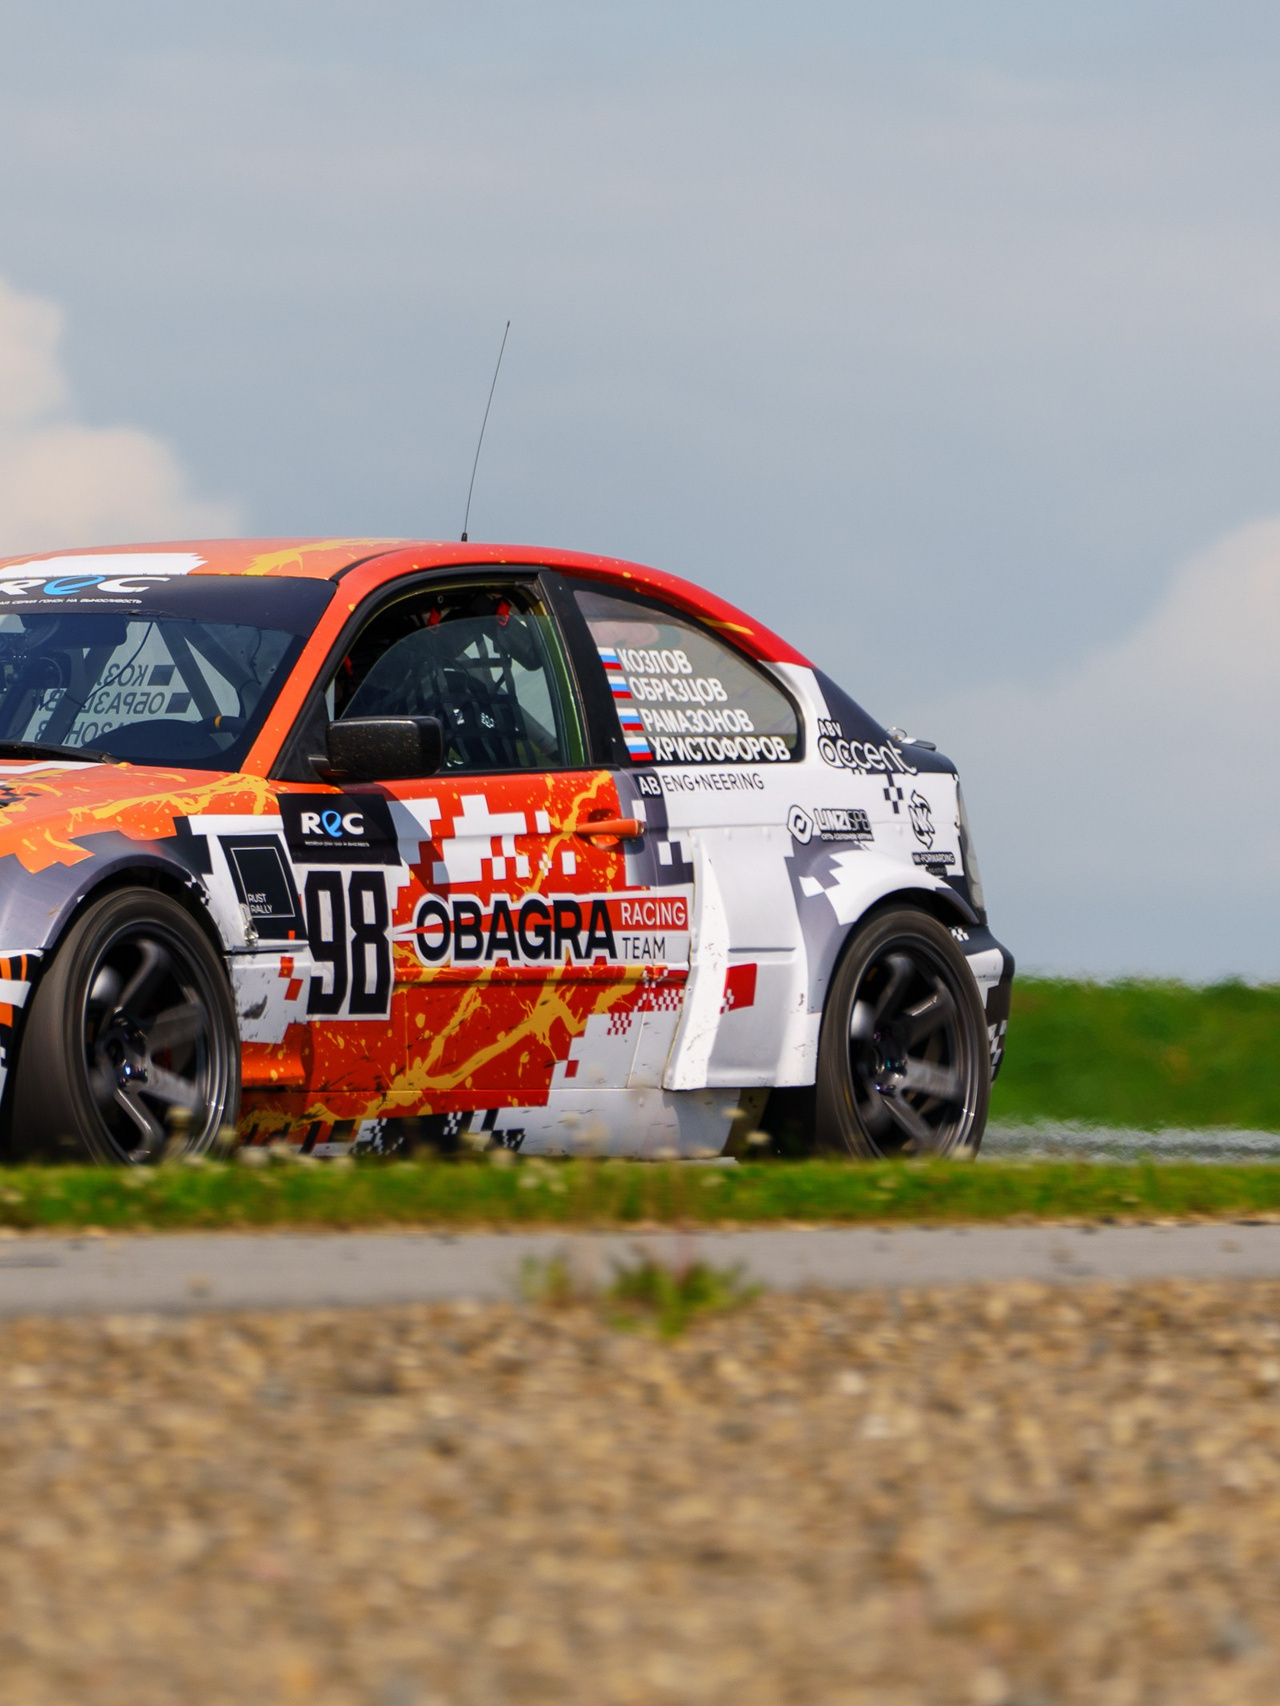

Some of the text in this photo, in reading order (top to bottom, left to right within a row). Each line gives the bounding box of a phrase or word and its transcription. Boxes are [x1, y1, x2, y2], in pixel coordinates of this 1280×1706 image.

[617, 648, 693, 674] КОЗЛОВ
[628, 677, 728, 706] ОБРАЗЦОВ
[639, 708, 754, 733] РАМАЗОНОВ
[818, 718, 842, 738] ABV
[648, 736, 791, 762] ХРИСТОФОРОВ
[639, 776, 661, 795] AB
[248, 893, 267, 903] RUST
[251, 904, 272, 914] RALLY
[416, 898, 687, 961] OBAGRA RACING
[304, 871, 392, 1015] 98
[622, 937, 666, 960] TEAM
